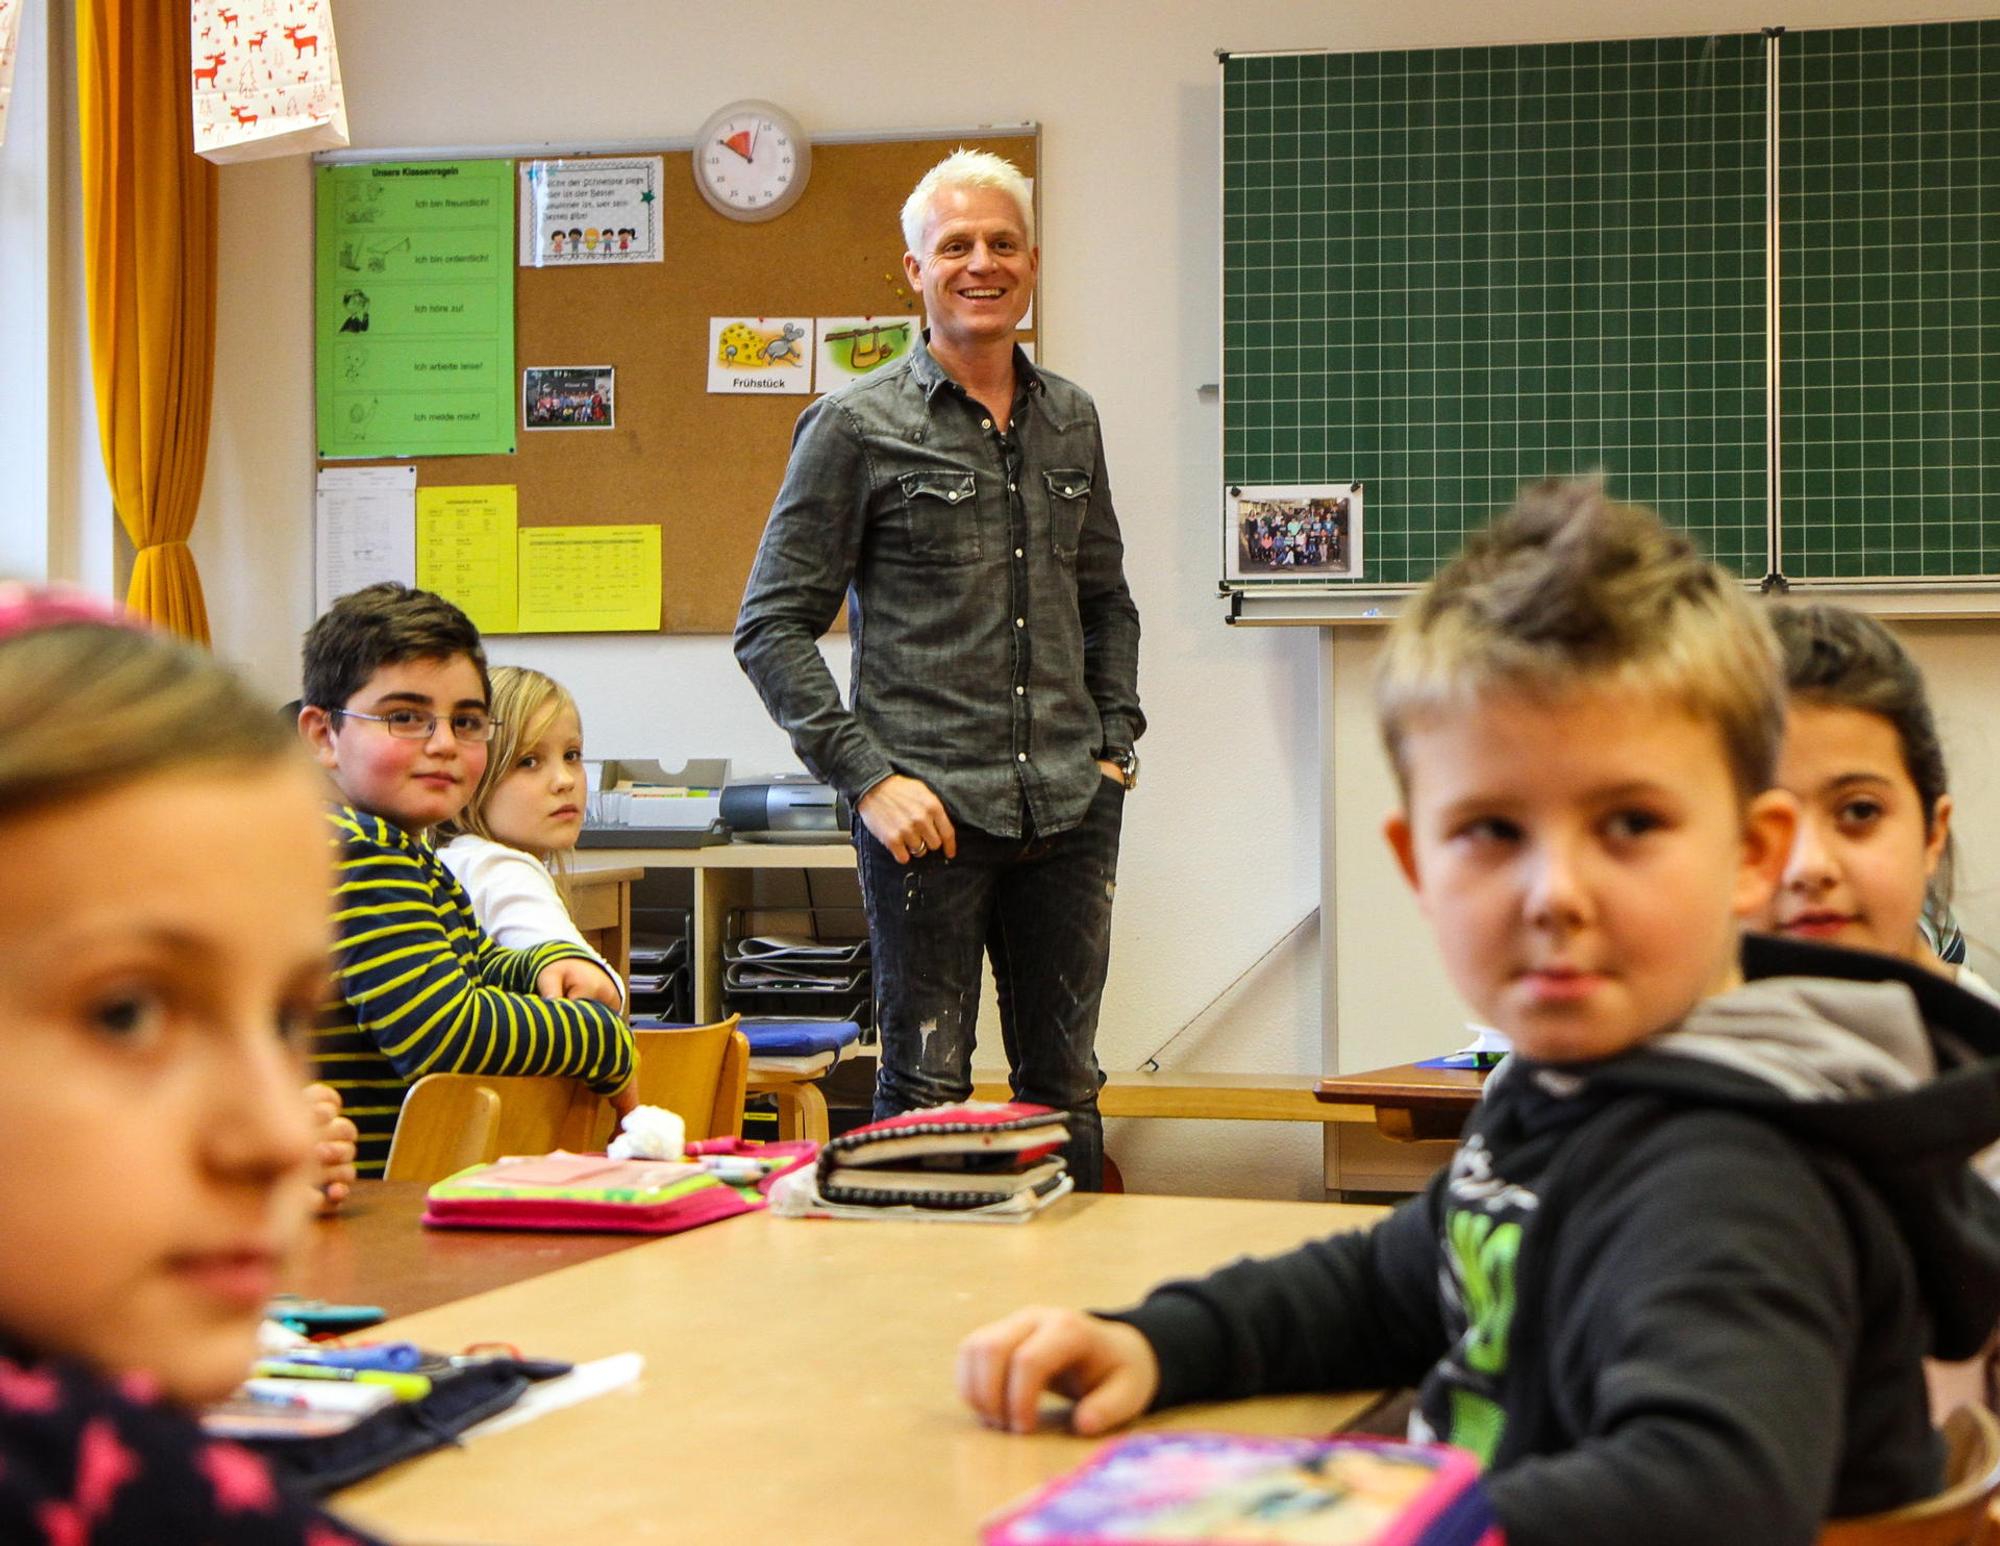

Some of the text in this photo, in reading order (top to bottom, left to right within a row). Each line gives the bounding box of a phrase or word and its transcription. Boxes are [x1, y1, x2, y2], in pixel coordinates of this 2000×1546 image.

[372, 166, 459, 178] Unsere Klassenregeln
[415, 199, 428, 209] Ich
[430, 199, 443, 208] bin
[415, 255, 428, 264] Ich
[430, 254, 443, 263] bin
[414, 304, 428, 313] Ich
[414, 363, 427, 371] Ich
[733, 378, 785, 389] Frühstück
[413, 413, 427, 421] Ich
